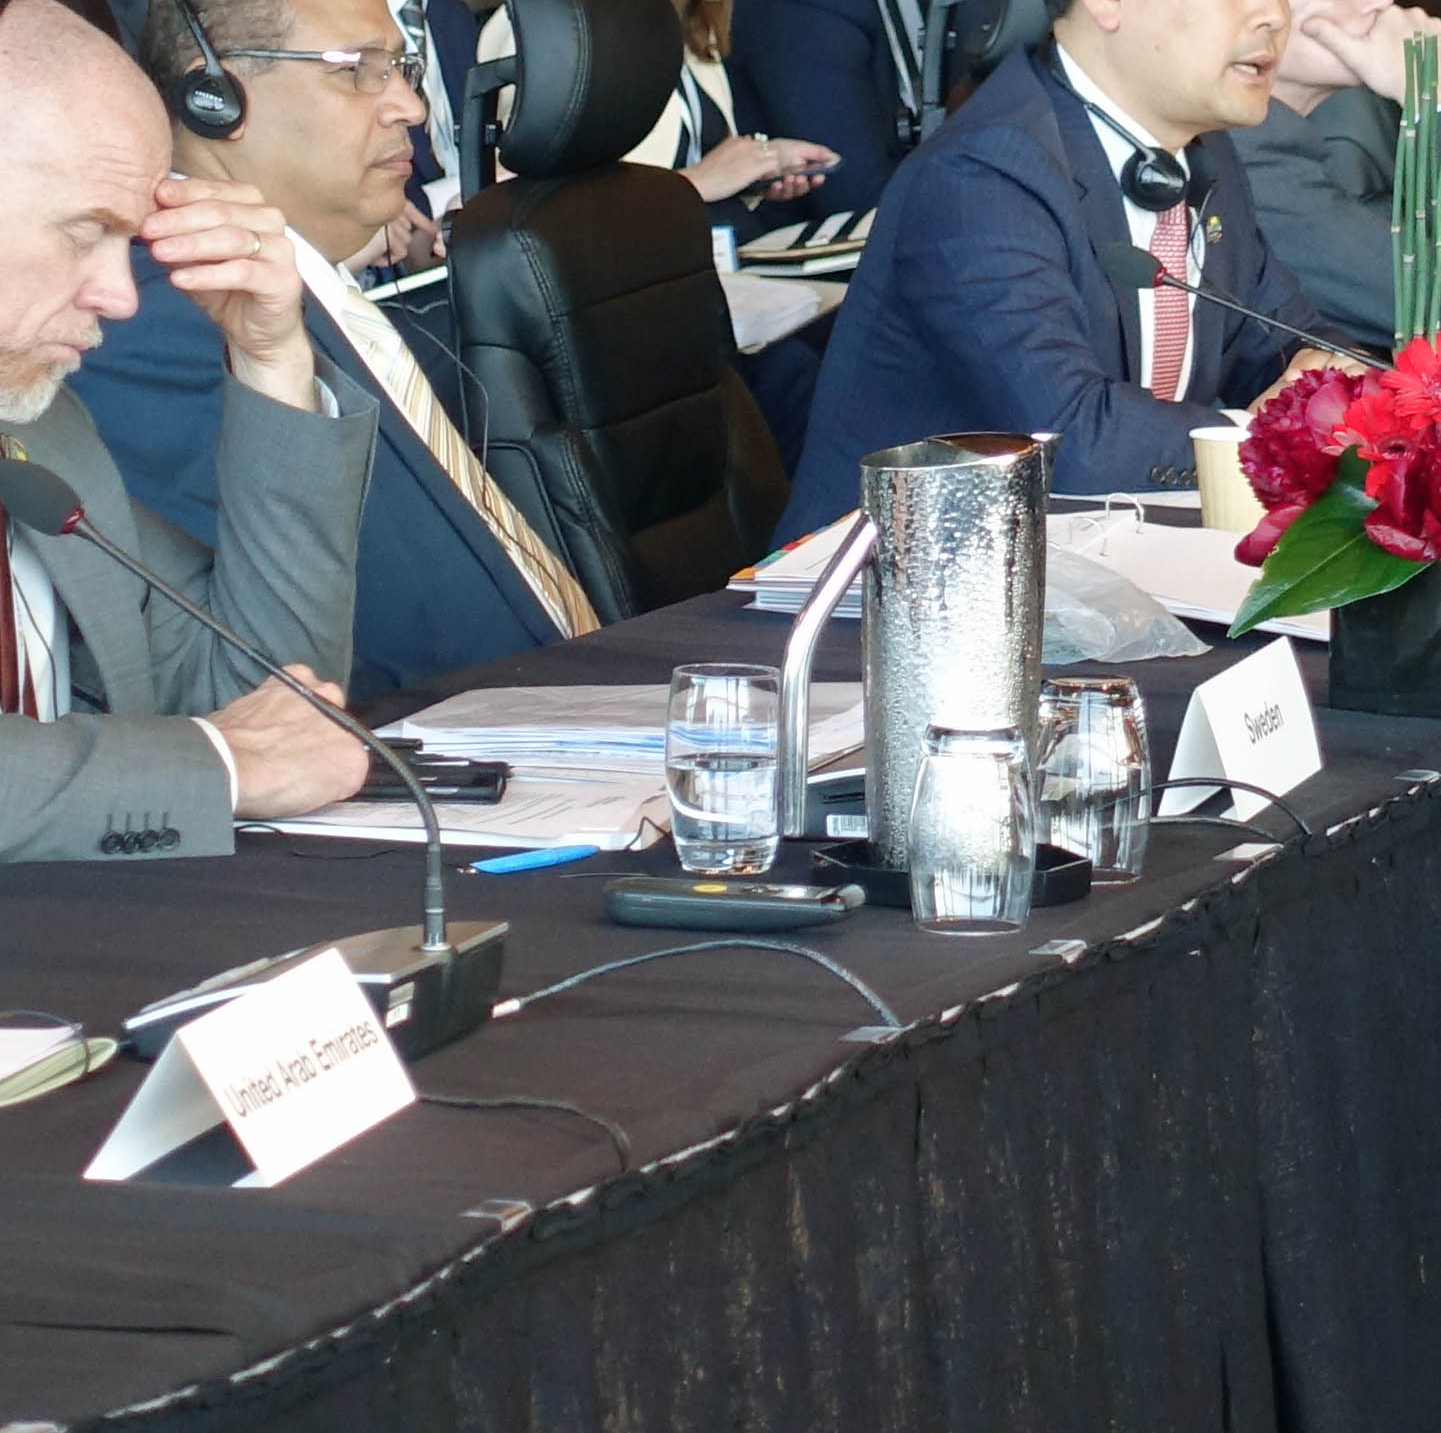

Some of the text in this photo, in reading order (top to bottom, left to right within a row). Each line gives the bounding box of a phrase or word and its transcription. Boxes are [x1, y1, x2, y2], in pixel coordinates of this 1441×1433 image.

[1244, 700, 1284, 745] Sweden
[224, 1021, 379, 1117] United Arab Emirates
